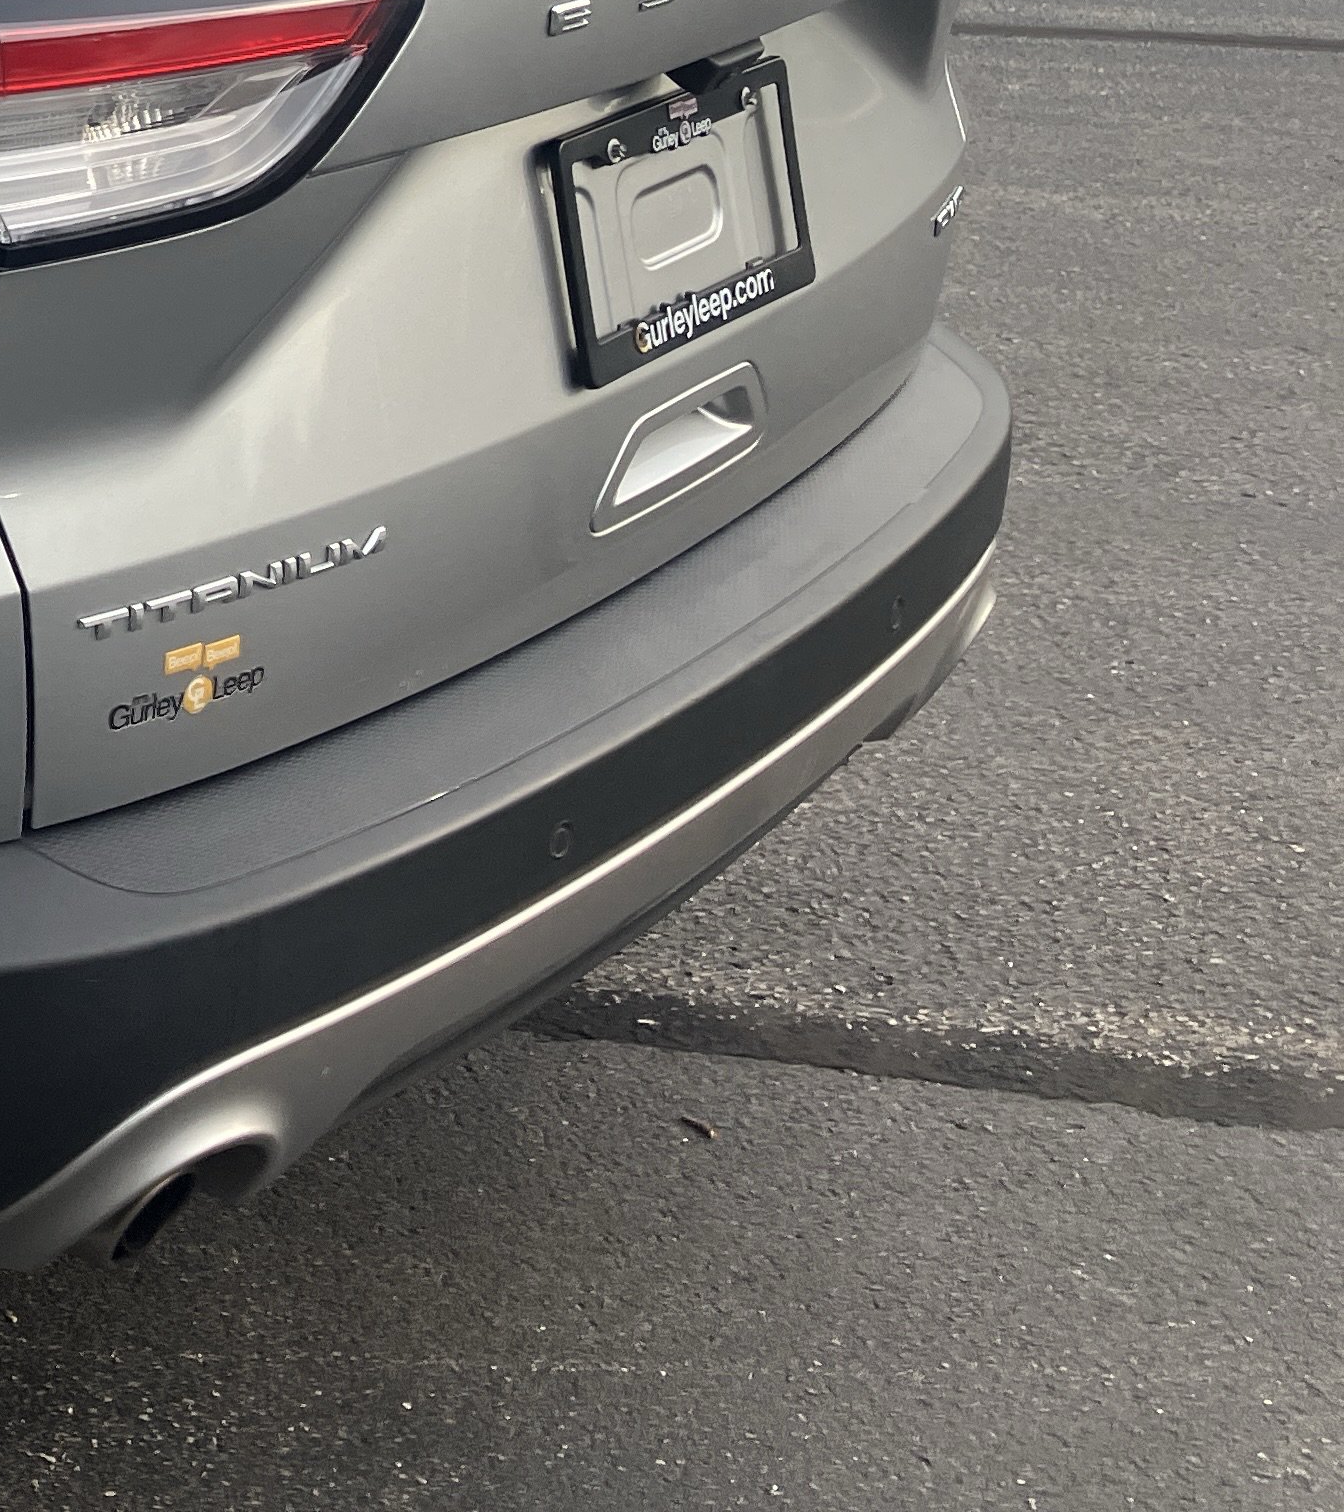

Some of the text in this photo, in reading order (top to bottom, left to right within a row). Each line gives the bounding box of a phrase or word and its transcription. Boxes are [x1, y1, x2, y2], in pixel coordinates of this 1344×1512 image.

[76, 525, 387, 641] TITANIUM
[108, 691, 184, 731] Gurley
[213, 666, 265, 700] Leep
